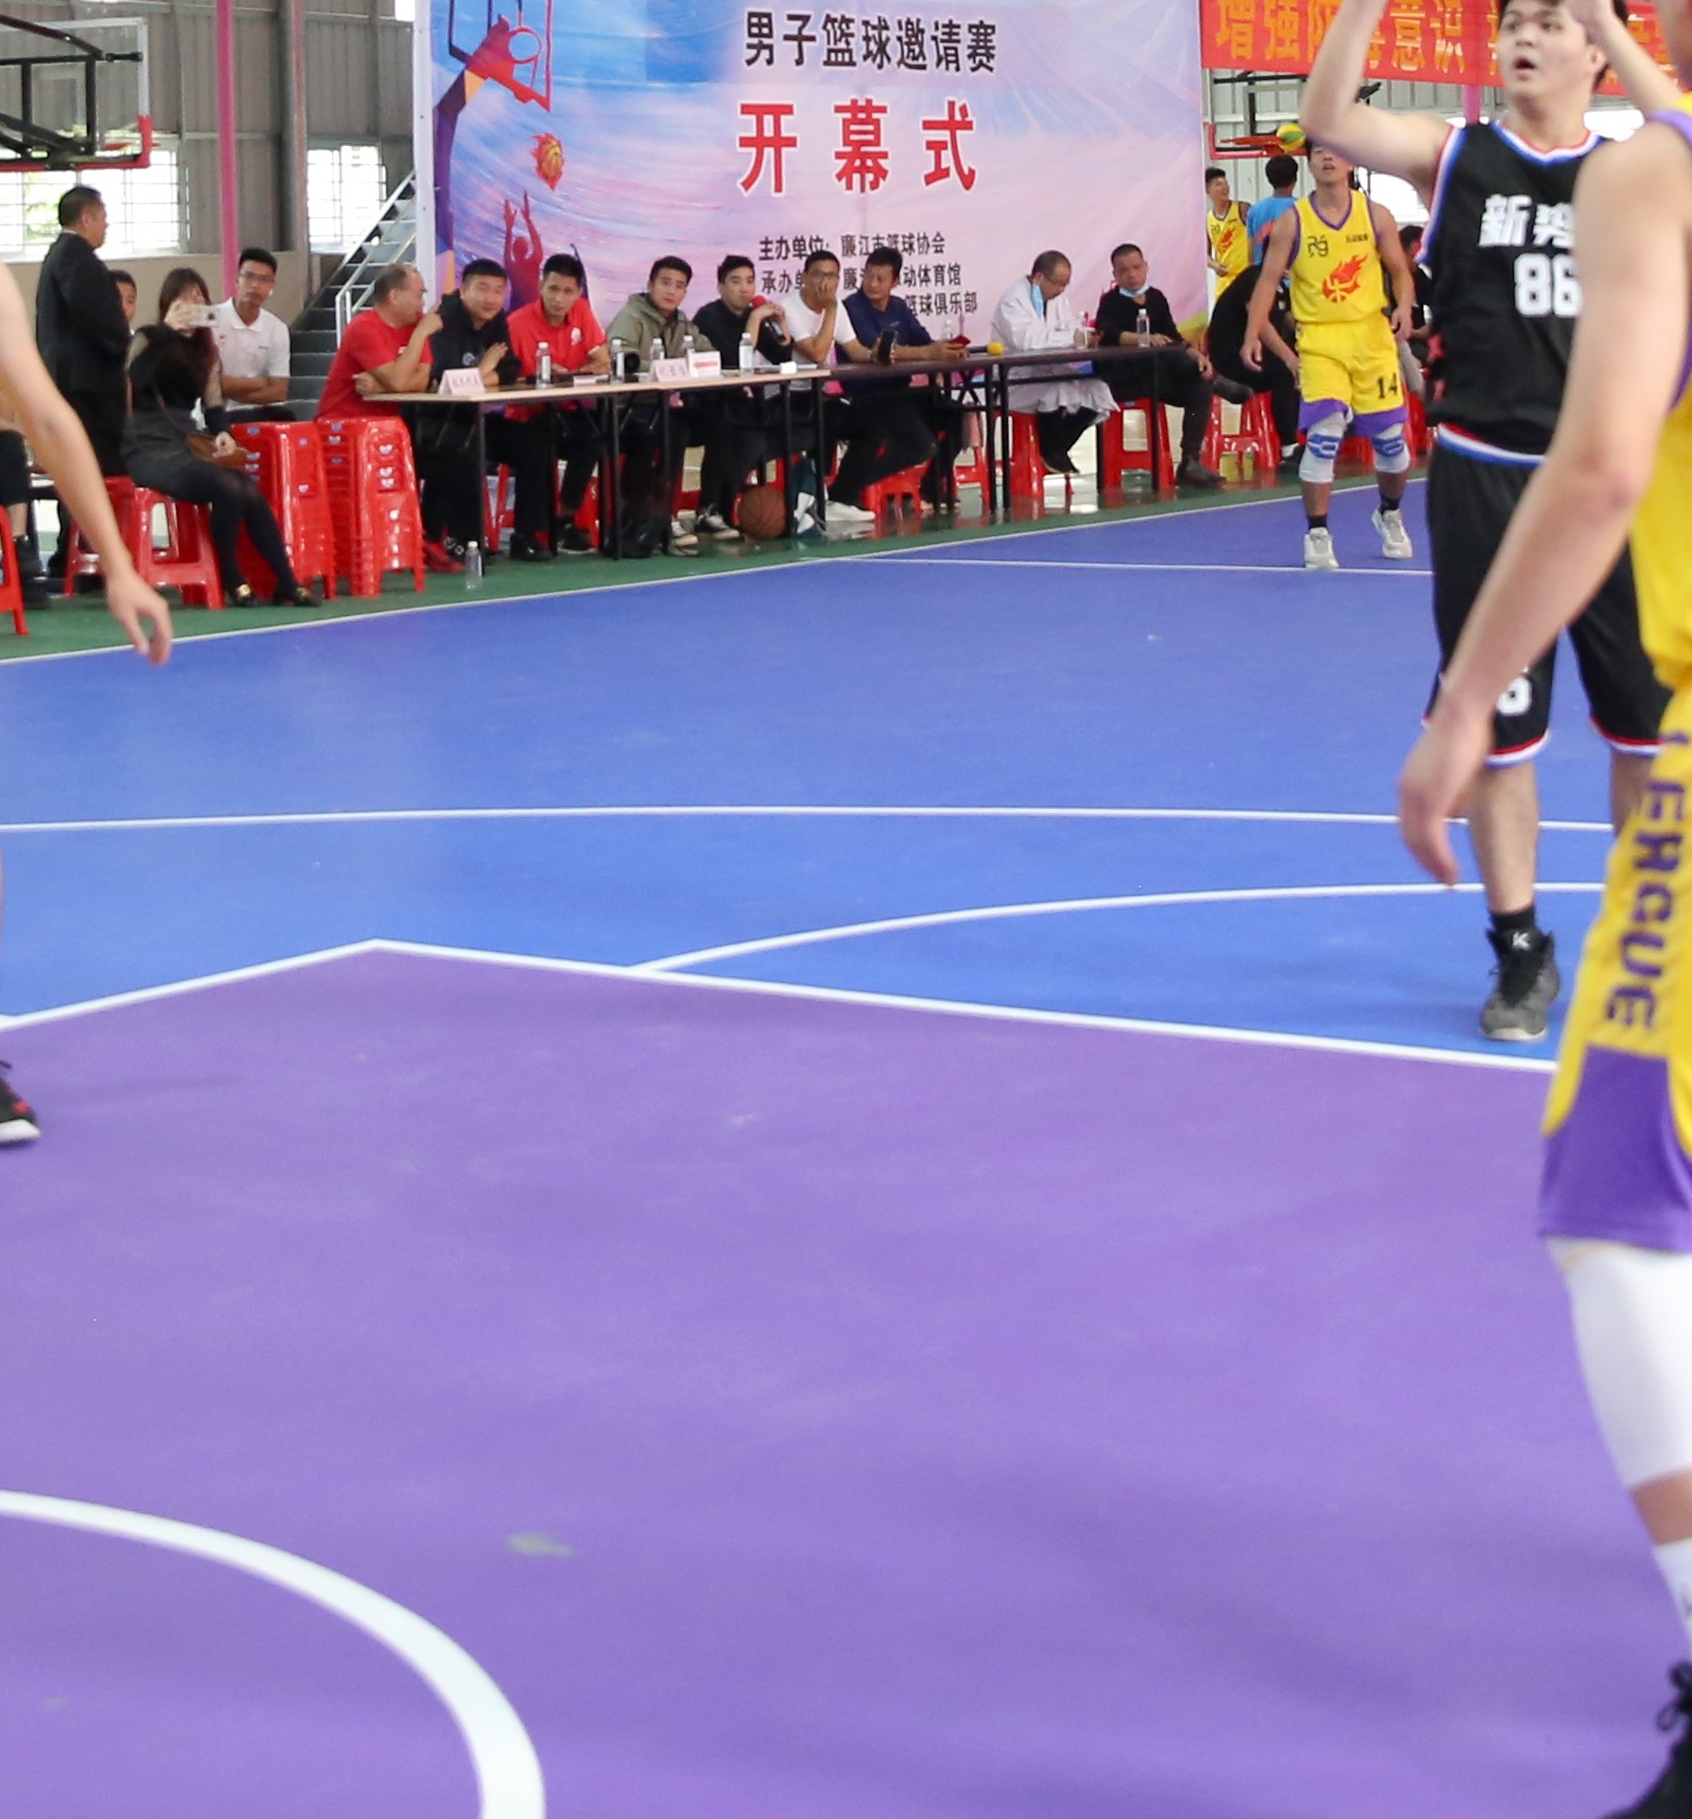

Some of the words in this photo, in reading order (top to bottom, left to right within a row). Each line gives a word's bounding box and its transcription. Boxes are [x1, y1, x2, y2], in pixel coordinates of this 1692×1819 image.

[744, 10, 998, 73] 男子篮球邀请赛
[737, 97, 978, 195] 开幕式
[1514, 253, 1583, 317] 86
[1376, 372, 1398, 400] 14
